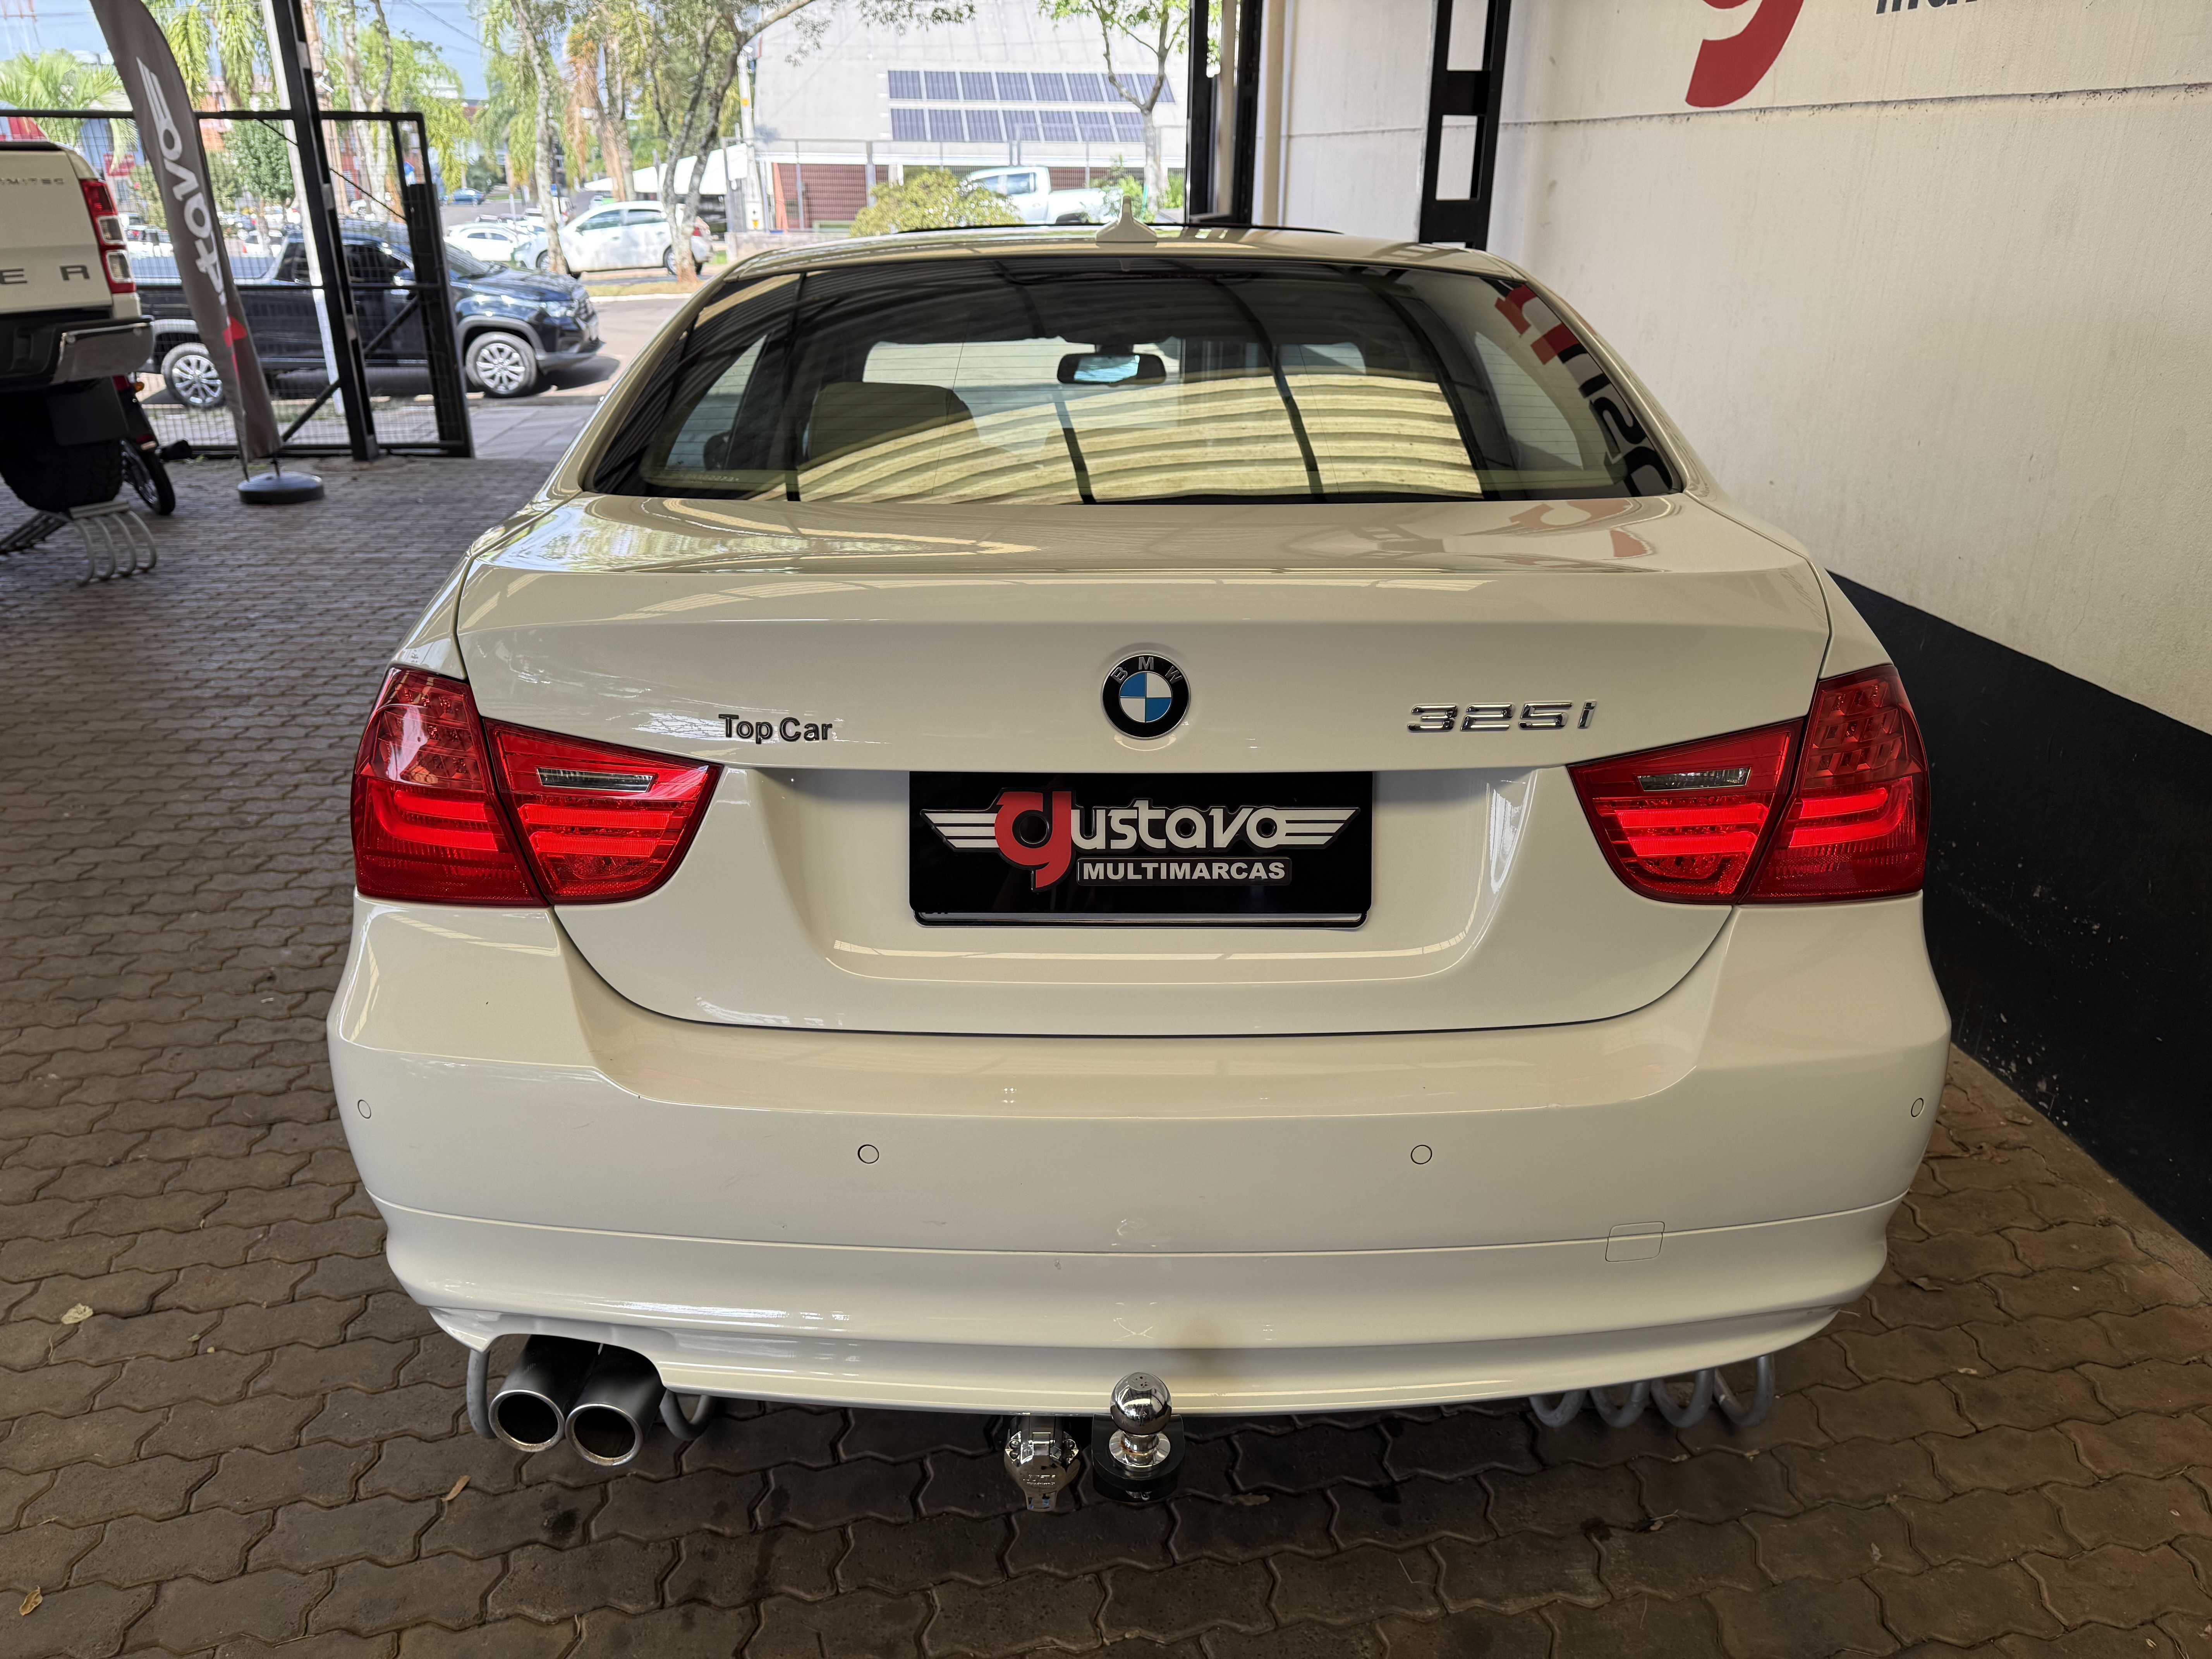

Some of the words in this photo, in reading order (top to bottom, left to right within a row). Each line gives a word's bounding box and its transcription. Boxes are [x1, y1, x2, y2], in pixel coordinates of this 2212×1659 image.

[1110, 656, 1183, 684] BMW
[718, 714, 773, 744] Top
[779, 717, 833, 742] Car
[1407, 701, 1597, 732] 325i
[994, 791, 1279, 888] gustavo
[1083, 862, 1285, 880] MULTIMARCAS
